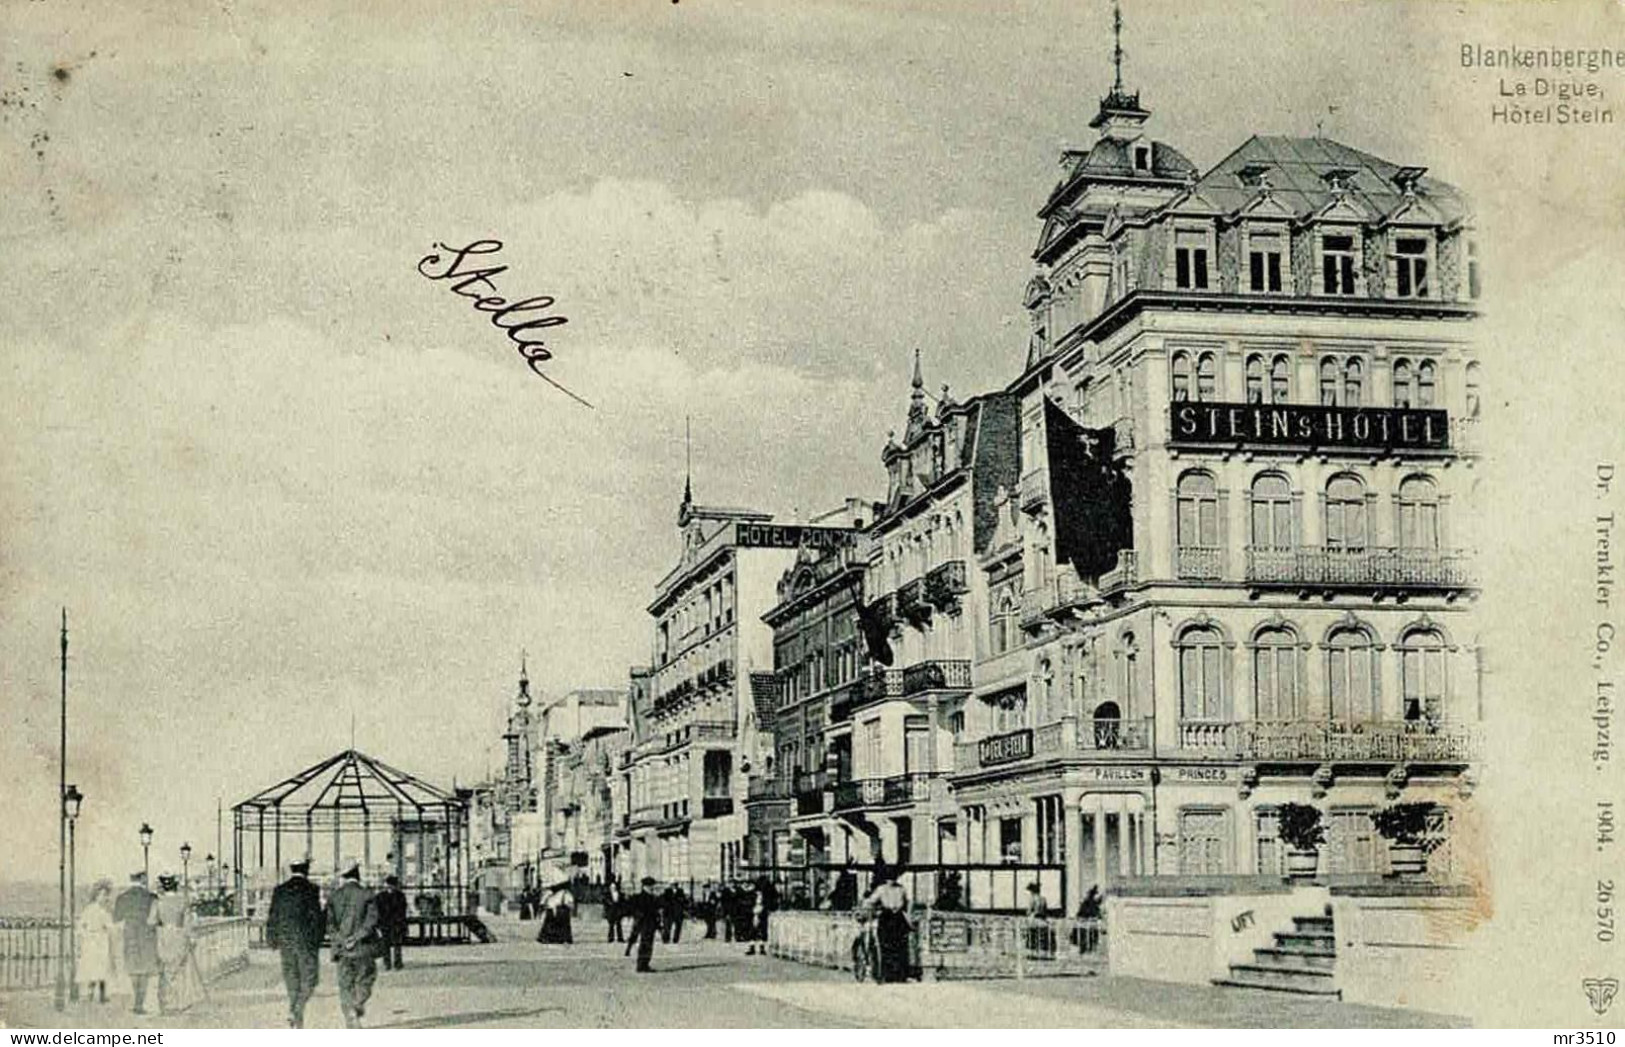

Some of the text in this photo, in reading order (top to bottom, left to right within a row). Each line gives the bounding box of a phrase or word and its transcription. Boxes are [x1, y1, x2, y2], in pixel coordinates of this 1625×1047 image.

[418, 240, 594, 409] Stella
[1325, 412, 1442, 442] HOTEL
[740, 525, 793, 546] HOTEL
